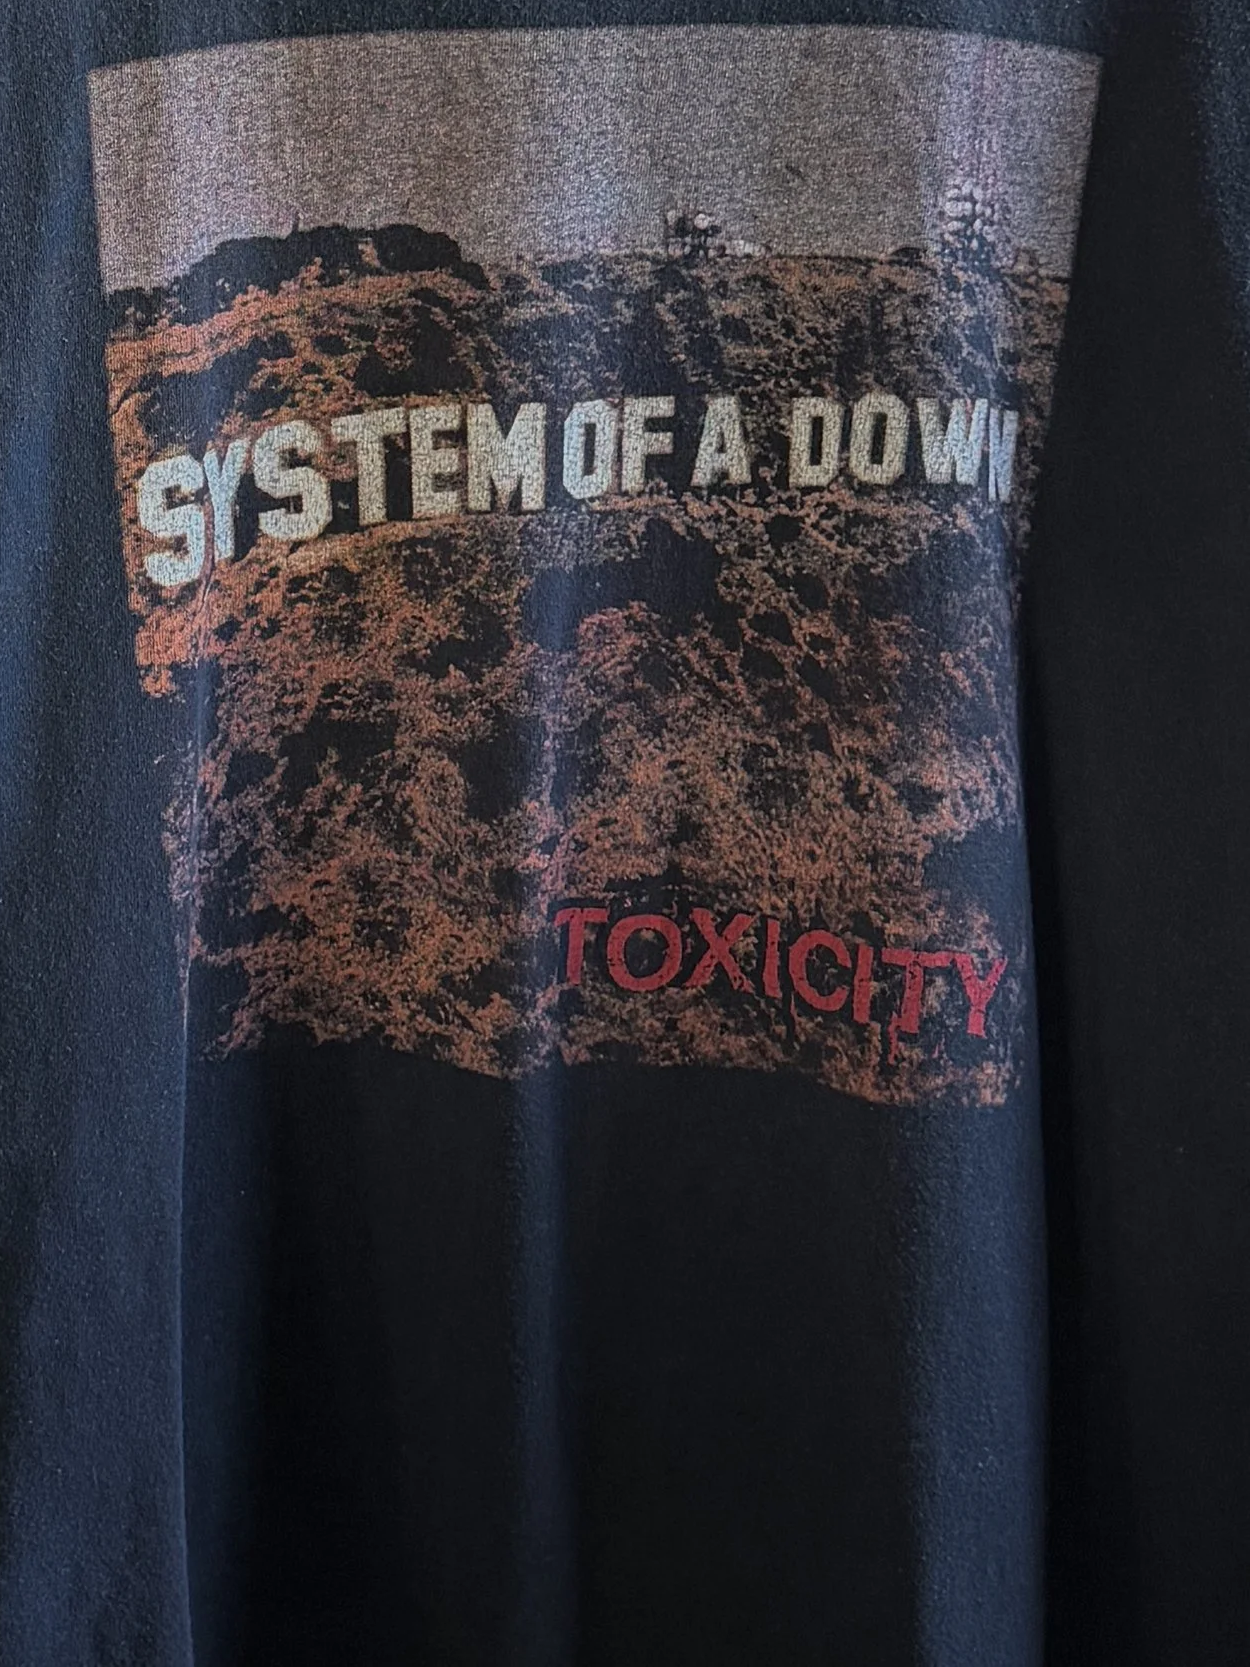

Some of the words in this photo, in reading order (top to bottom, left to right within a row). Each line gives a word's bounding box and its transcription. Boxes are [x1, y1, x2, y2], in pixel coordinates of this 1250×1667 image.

[136, 400, 547, 586] SYSTEM
[561, 395, 674, 501] OF
[691, 396, 753, 488] A
[787, 392, 1020, 504] DOWN
[553, 906, 1008, 1039] TOXICITY
